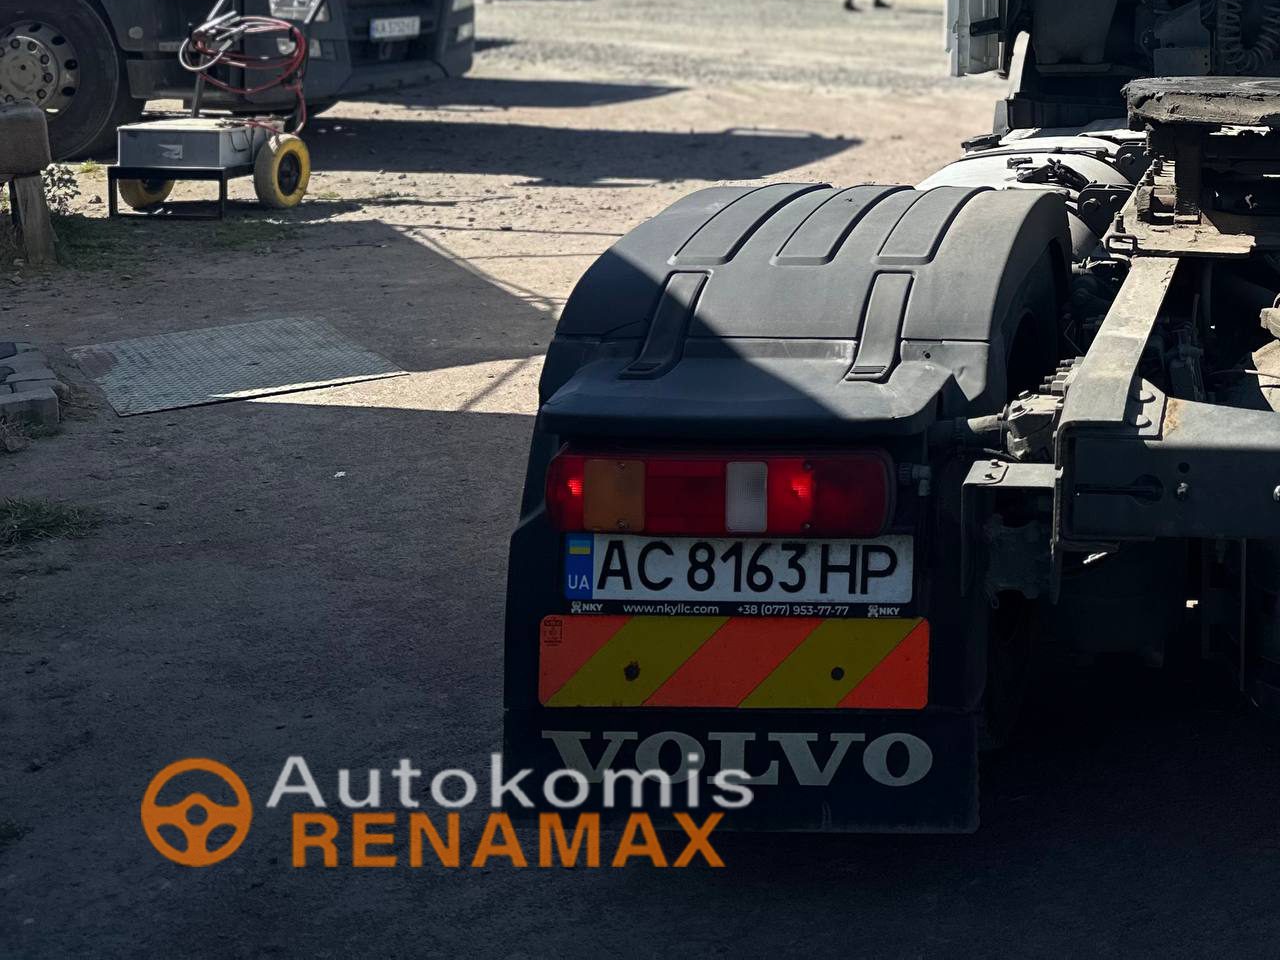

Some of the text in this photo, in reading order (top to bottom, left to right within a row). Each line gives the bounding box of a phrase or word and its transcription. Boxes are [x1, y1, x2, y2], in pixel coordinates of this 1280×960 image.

[596, 540, 898, 595] AC 8163 HP
[568, 575, 590, 590] UA
[582, 603, 603, 611] NKY
[623, 603, 720, 615] www.nkyllc.com
[737, 605, 849, 616] +38 (077) 953-77-77
[879, 607, 900, 616] NKY
[541, 729, 934, 786] VOLVO
